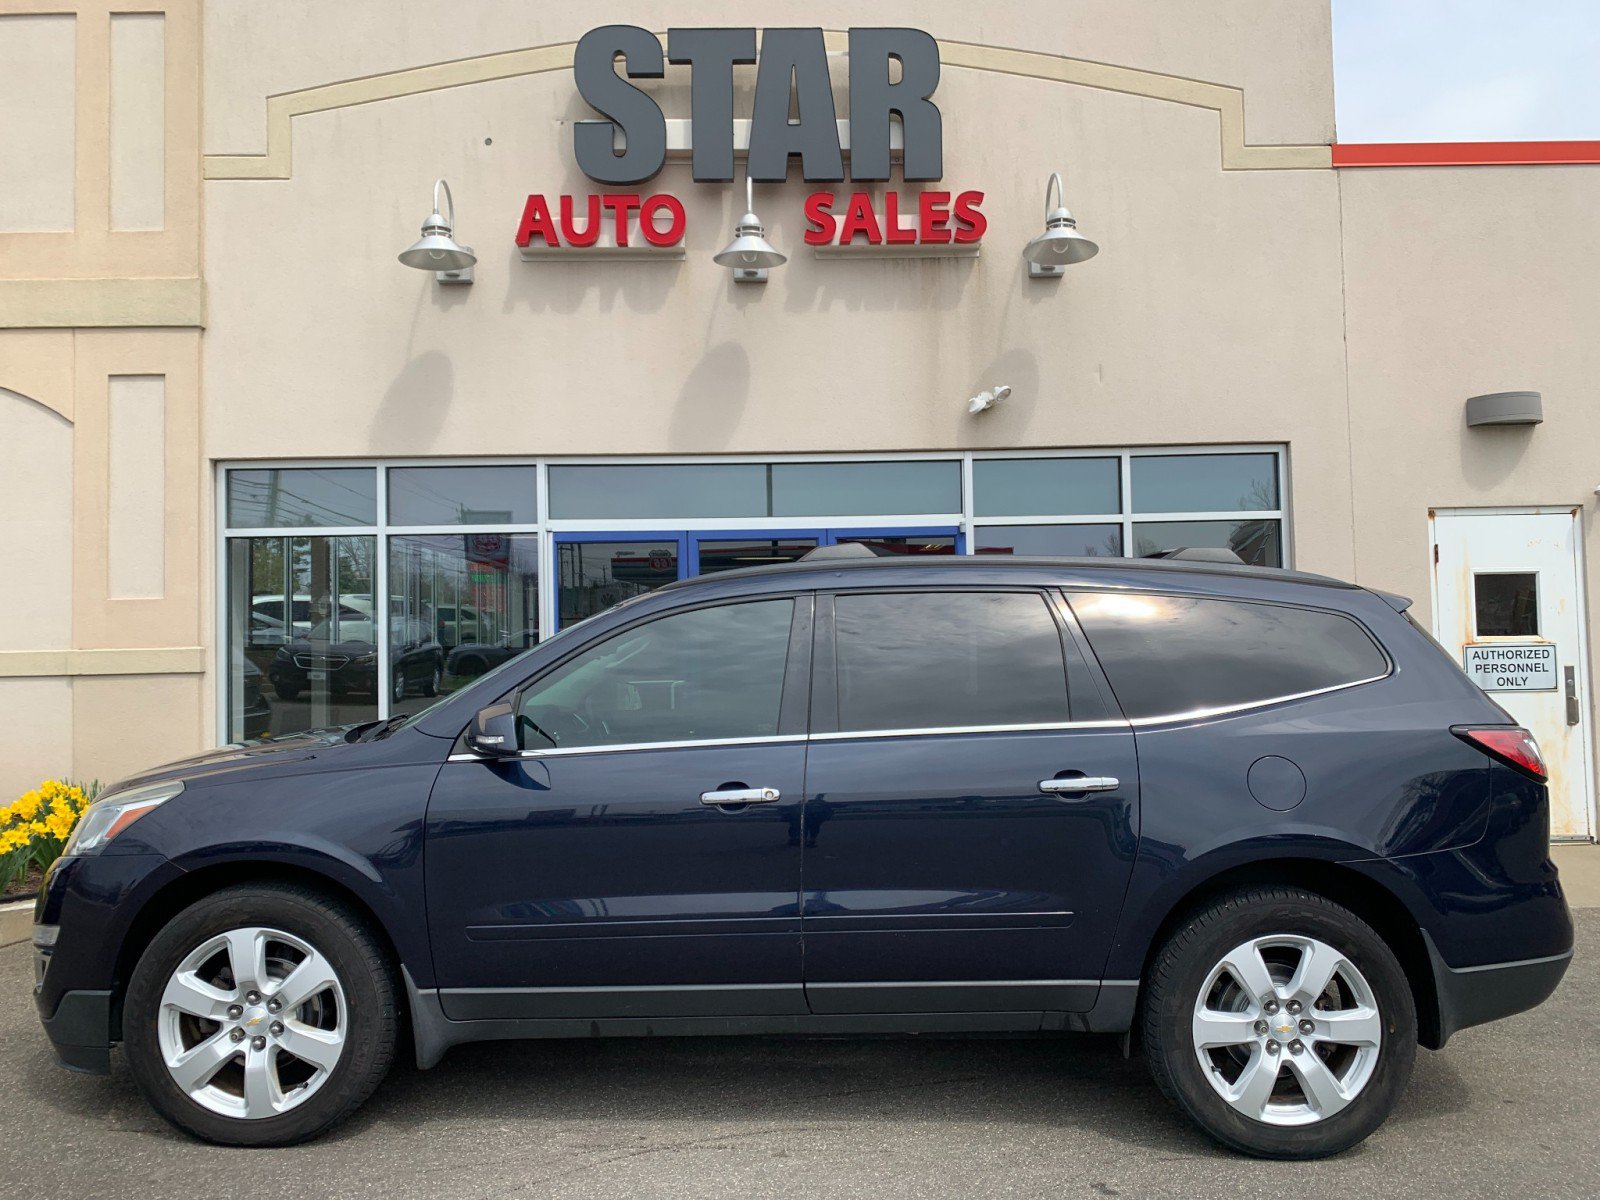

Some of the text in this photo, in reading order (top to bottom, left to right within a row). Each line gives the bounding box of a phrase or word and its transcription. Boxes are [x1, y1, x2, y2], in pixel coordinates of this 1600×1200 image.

[574, 25, 943, 185] STAR
[515, 190, 988, 248] AUTO SALES
[1472, 649, 1550, 660] AUTHORIZED
[1475, 663, 1549, 673] PERSONNEL
[1497, 676, 1528, 687] ONLY
